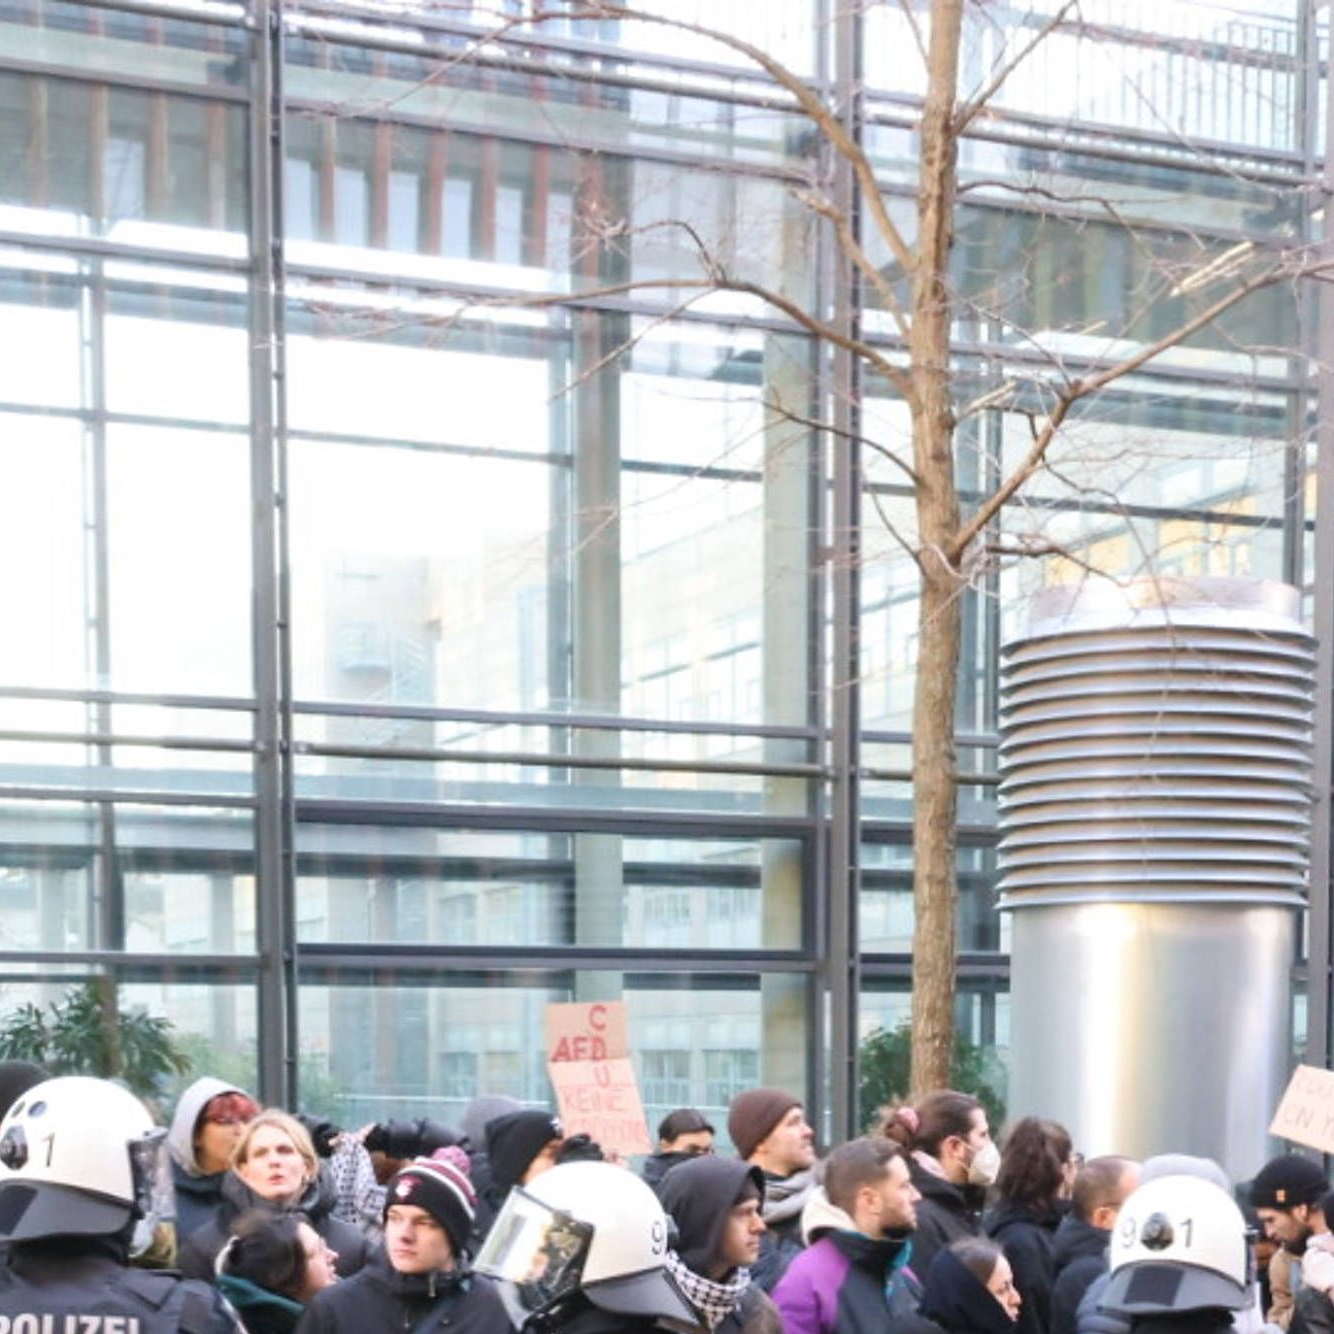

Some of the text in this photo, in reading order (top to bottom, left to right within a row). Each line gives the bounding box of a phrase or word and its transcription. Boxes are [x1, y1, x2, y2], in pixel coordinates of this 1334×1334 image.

[551, 1035, 607, 1063] AFD
[41, 1132, 56, 1167] 1
[1121, 1216, 1136, 1249] 9
[1179, 1217, 1194, 1249] 1
